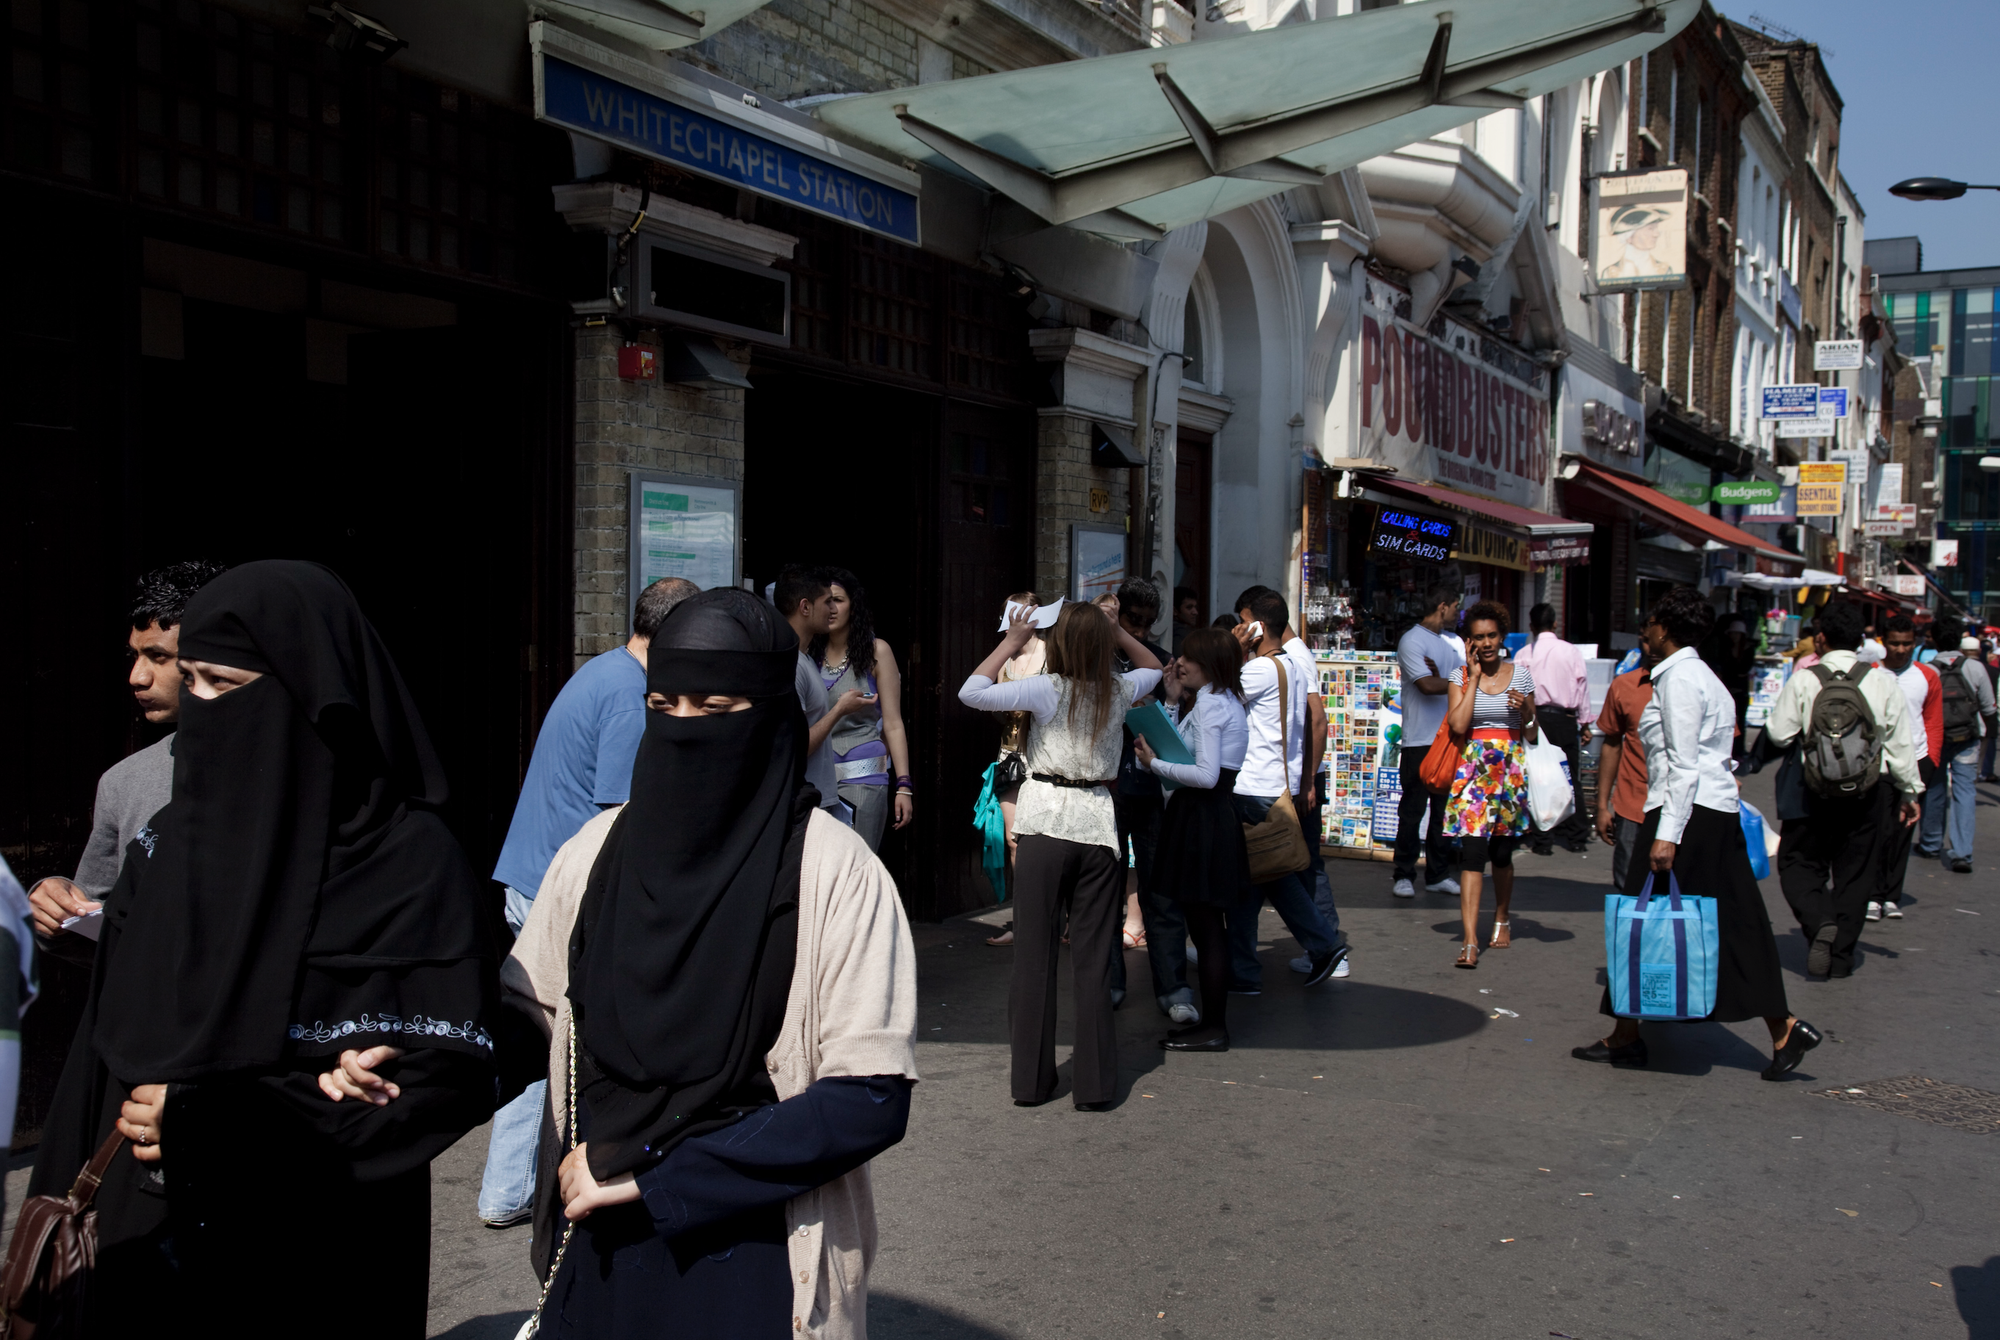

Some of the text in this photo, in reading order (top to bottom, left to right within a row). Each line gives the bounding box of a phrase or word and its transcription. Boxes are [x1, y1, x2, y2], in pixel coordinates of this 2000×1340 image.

[582, 80, 894, 226] WHITECHAPEL STATION
[1764, 387, 1816, 395] HAMEEM
[1362, 313, 1551, 488] POUNDBUSTERS
[1091, 492, 1109, 509] RVP
[1720, 486, 1773, 500] Budgens
[1798, 487, 1838, 501] SSENTIAL
[1381, 511, 1420, 530] CALLING
[1420, 520, 1452, 538] CARDS
[1406, 530, 1420, 541] &
[1377, 534, 1403, 551] SIM
[1403, 539, 1447, 561] CARDS
